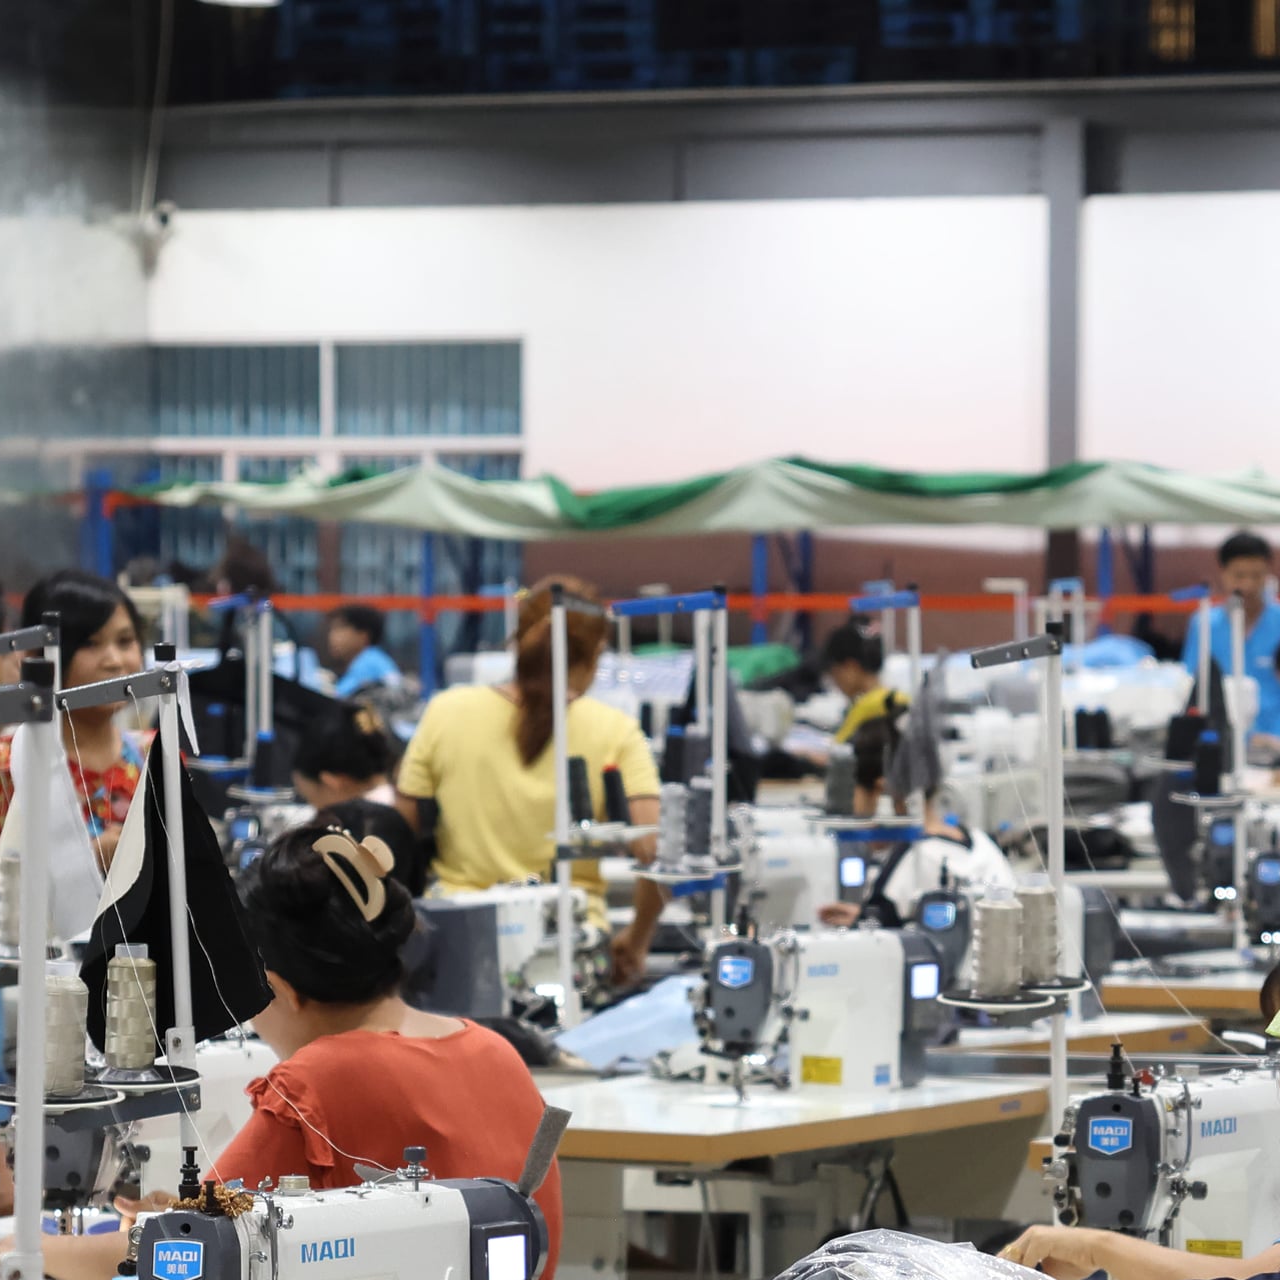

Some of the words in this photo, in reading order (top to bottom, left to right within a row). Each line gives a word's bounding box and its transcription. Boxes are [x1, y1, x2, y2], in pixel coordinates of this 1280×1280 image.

[1093, 1126, 1128, 1137] MAQI
[1200, 1117, 1238, 1138] MAQI
[158, 1251, 198, 1263] MAQI
[301, 1237, 355, 1264] MAQI
